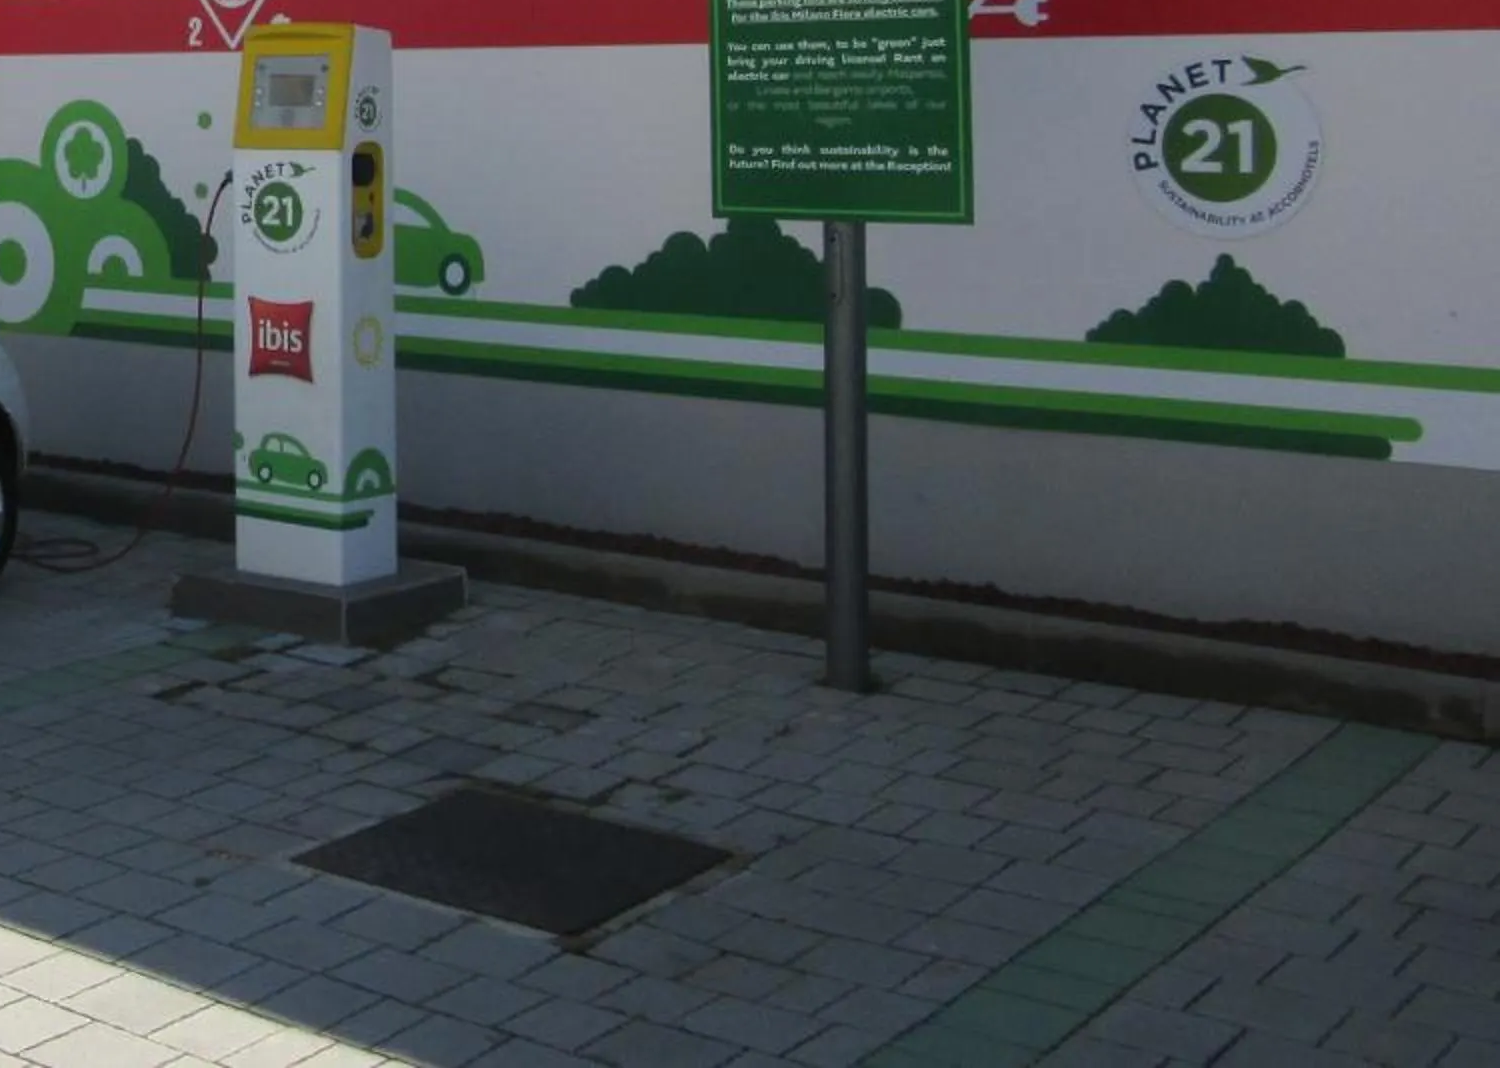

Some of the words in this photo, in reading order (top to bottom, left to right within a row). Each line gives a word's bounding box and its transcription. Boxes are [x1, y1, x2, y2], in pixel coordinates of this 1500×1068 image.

[188, 16, 203, 47] 2
[751, 42, 771, 51] can
[835, 39, 849, 49] to
[852, 36, 868, 49] be
[727, 55, 756, 69] bring
[761, 57, 789, 69] your
[794, 53, 835, 68] driving
[727, 70, 769, 81] electric
[1132, 58, 1233, 173] PLANET
[752, 146, 774, 157] you
[781, 143, 811, 155] think
[927, 143, 949, 157] the
[1180, 118, 1254, 175] 21
[865, 159, 886, 171] the
[241, 162, 285, 224] PLANET
[1157, 179, 1246, 227] SUSTAINABILITY
[261, 195, 294, 227] 21
[258, 320, 302, 353] ibis
